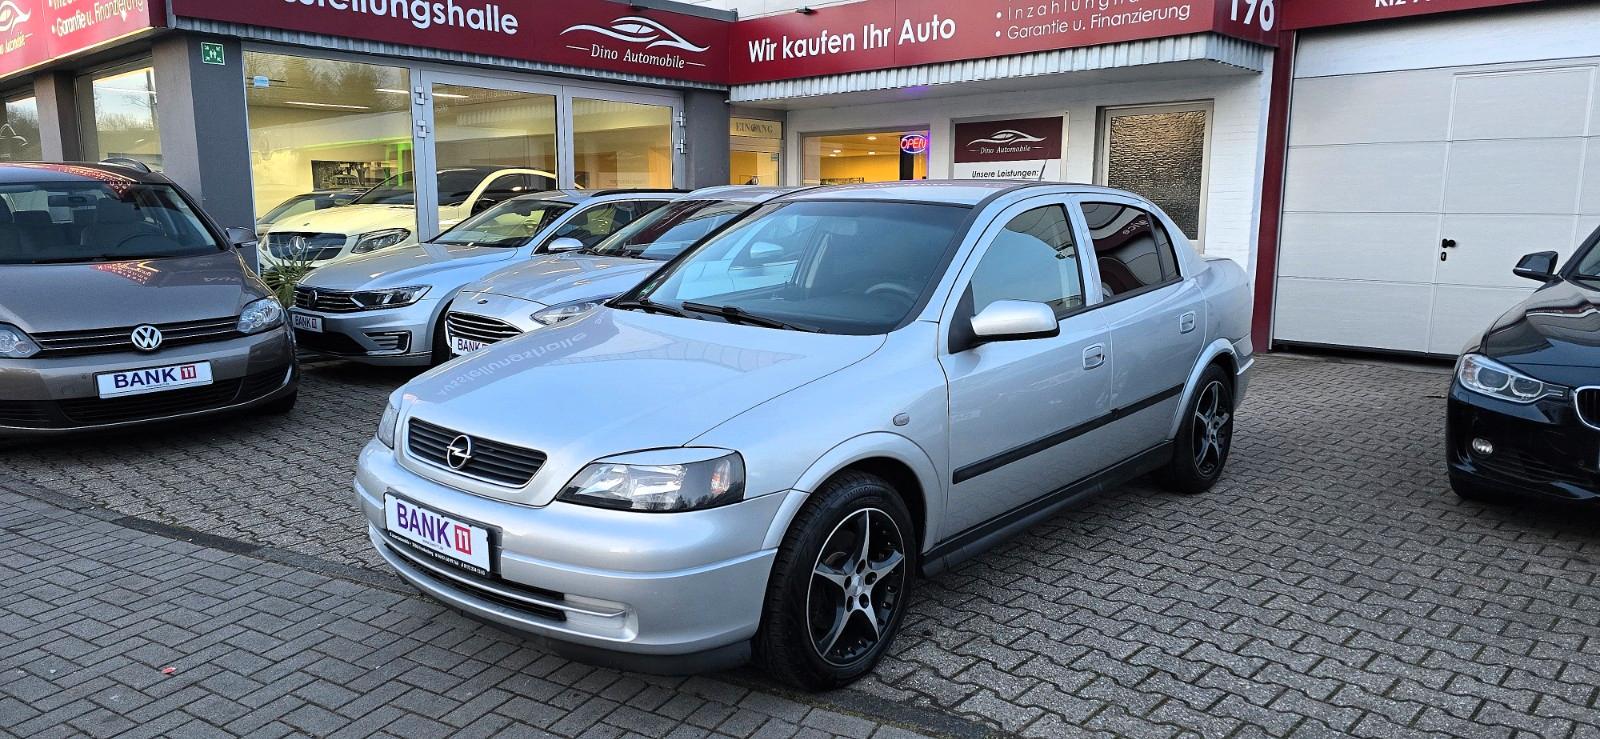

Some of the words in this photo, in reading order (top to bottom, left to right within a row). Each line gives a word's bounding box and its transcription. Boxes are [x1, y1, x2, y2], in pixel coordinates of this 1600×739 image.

[56, 9, 87, 37] Garantie
[1007, 19, 1068, 41] Garantie
[1073, 20, 1086, 32] u.
[1090, 3, 1191, 29] Finanzierung
[748, 37, 778, 63] Wir
[782, 29, 855, 59] kaufen
[863, 23, 891, 50] Ihr
[898, 14, 956, 46] Auto
[591, 43, 618, 60] Dino
[623, 48, 685, 69] Automobile
[736, 122, 773, 134] EINGANG
[901, 136, 926, 149] OPEN
[980, 146, 994, 155] Dino
[996, 144, 1031, 154] Automobile
[972, 170, 995, 179] Unsere
[997, 168, 1039, 180] Leistungen:
[113, 367, 177, 389] BANK
[396, 502, 451, 548] BANK
[454, 525, 471, 554] 11
